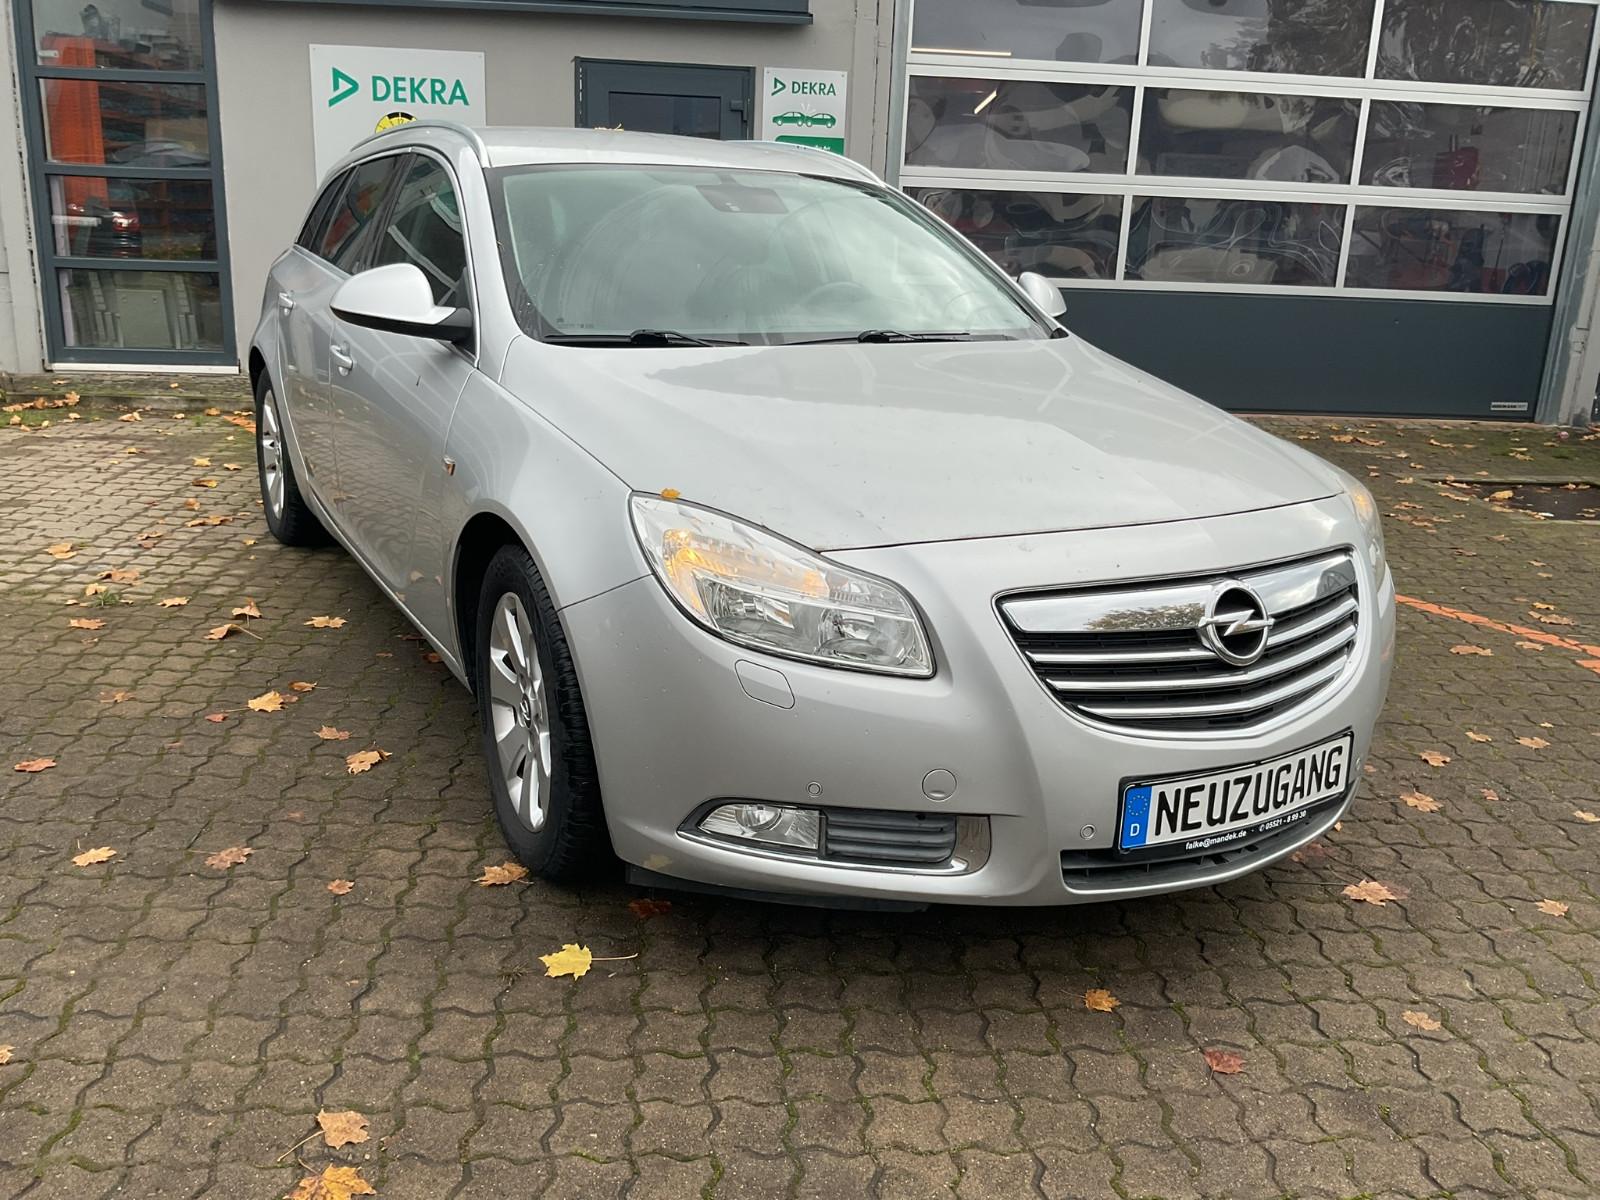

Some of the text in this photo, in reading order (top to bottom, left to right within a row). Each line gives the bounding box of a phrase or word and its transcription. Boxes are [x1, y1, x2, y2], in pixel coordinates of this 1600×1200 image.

[371, 75, 470, 106] DEKRA
[791, 80, 837, 97] DEKRA
[1154, 745, 1343, 836] NEUZUGANG
[1130, 823, 1140, 837] D
